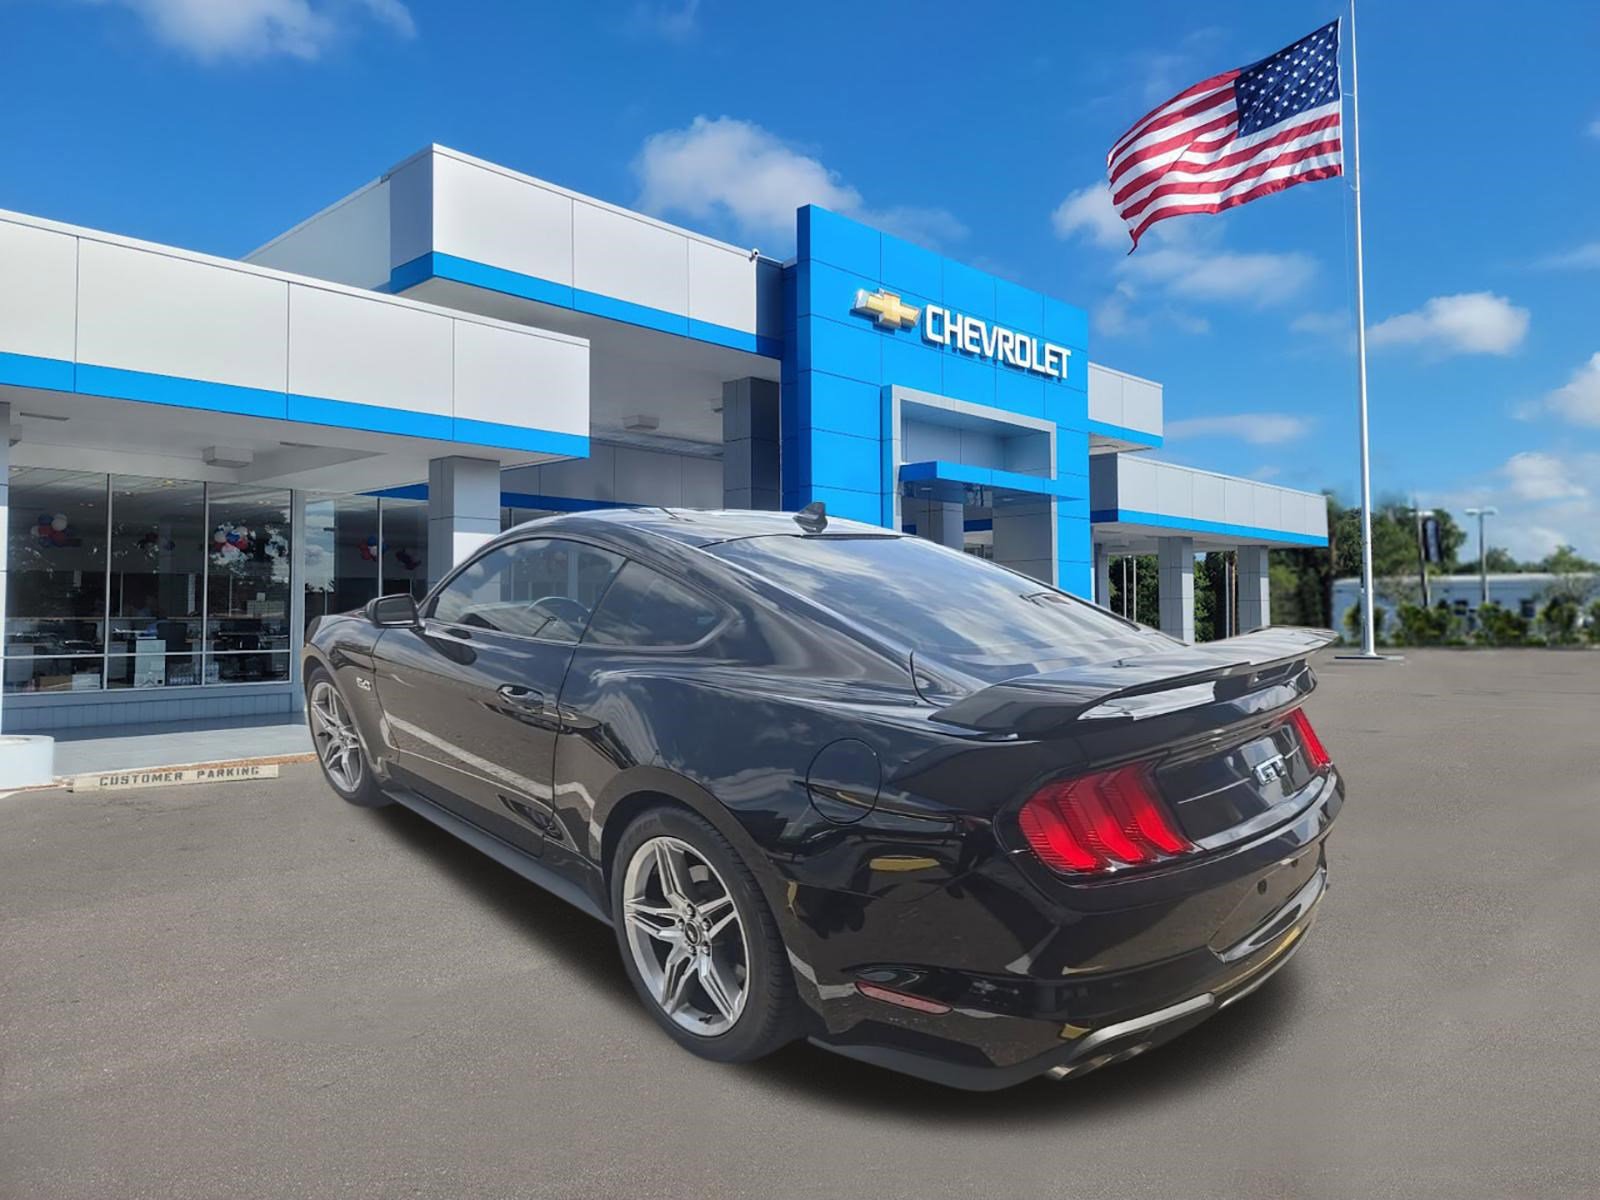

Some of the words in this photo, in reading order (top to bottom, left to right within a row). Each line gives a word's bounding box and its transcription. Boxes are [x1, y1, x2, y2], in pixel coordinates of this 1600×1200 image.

[925, 304, 1072, 379] CHEVROLET
[99, 772, 183, 786] CUSTOMER
[196, 766, 259, 779] PARKING
[1255, 754, 1286, 785] GT
